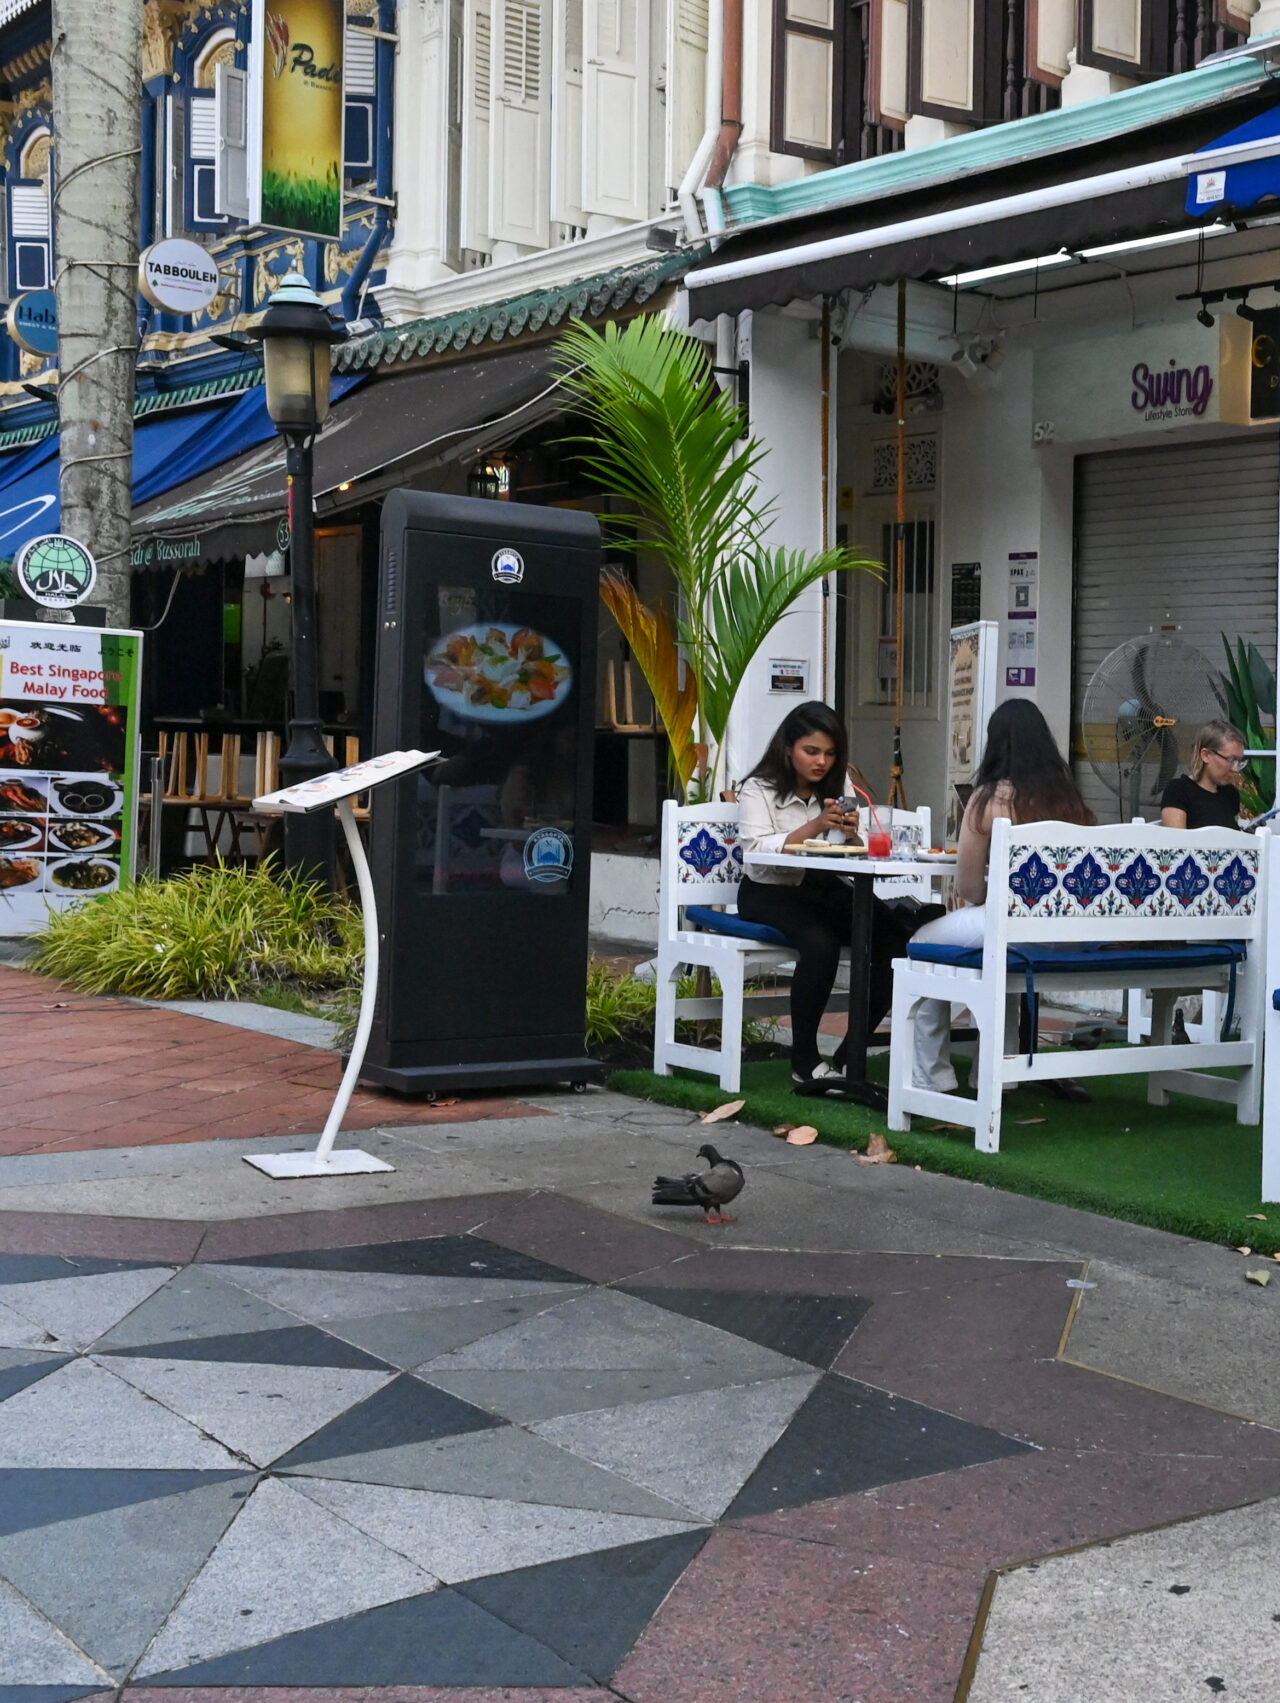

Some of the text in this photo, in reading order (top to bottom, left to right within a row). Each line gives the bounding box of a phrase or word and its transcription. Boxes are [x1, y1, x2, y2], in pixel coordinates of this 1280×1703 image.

[147, 261, 217, 284] TABBOULEH
[1132, 358, 1214, 416] Swing
[1145, 405, 1195, 422] Lifestyle Store
[156, 537, 201, 561] Bussorah
[29, 641, 82, 653] 欢迎光临
[10, 661, 123, 682] Best Singapore
[23, 681, 109, 699] Malay Food
